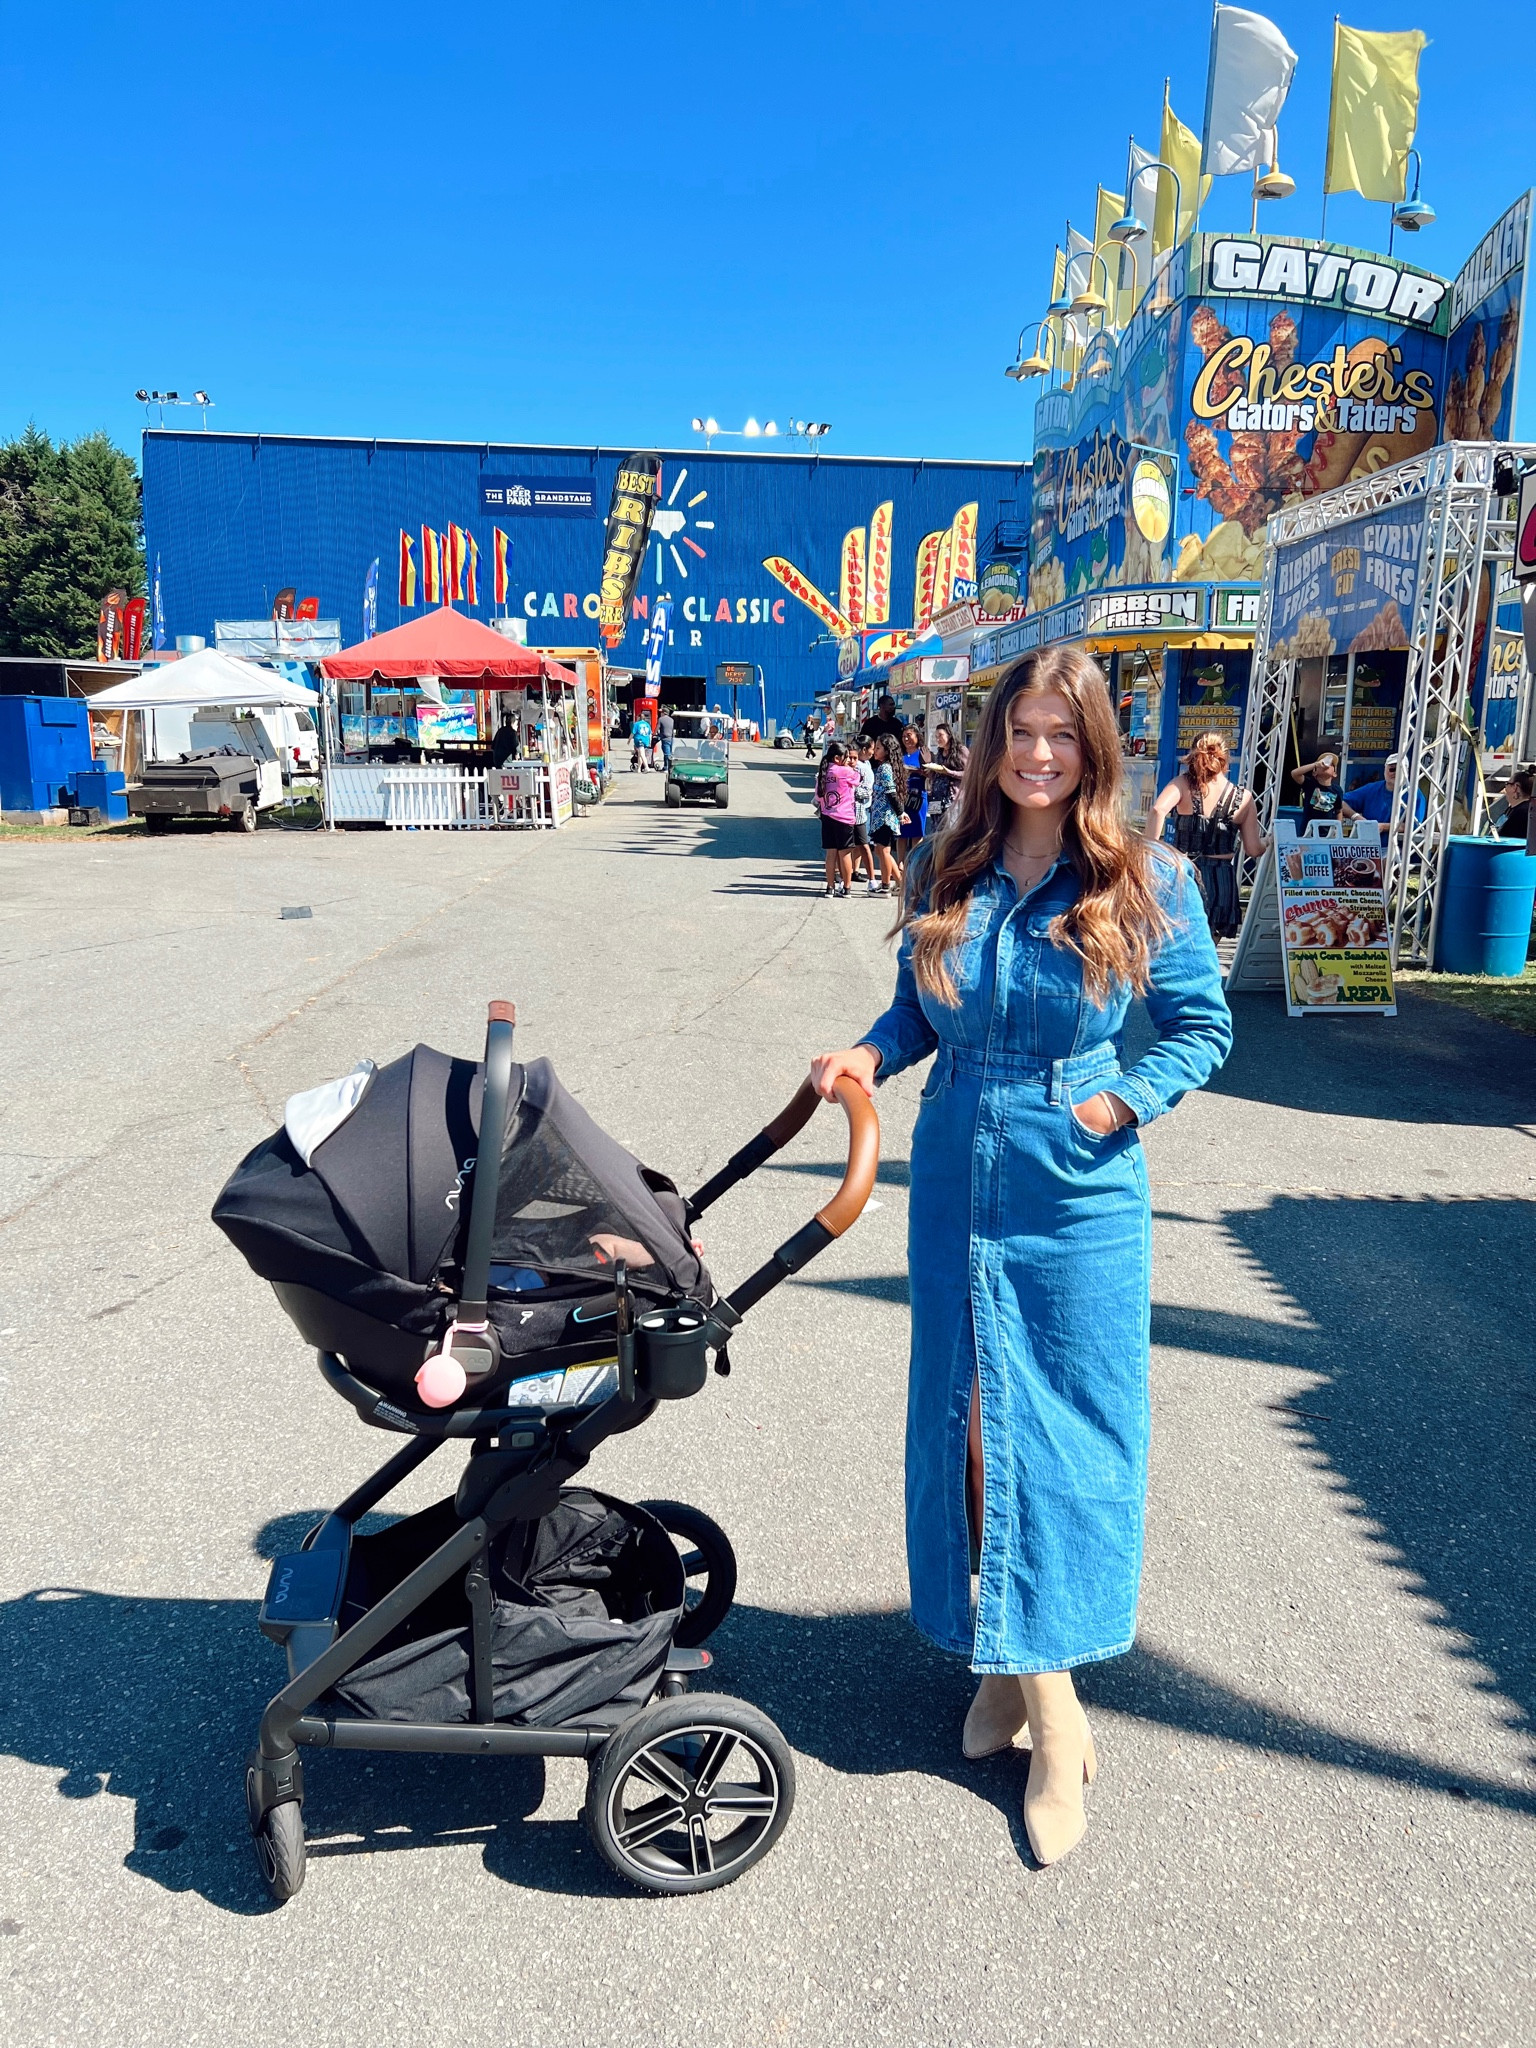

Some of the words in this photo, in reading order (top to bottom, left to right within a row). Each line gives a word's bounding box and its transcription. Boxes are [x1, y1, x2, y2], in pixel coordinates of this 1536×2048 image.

[1450, 196, 1528, 332] CHICKEN
[1210, 240, 1446, 325] GATOR
[1120, 248, 1185, 380] GATOR
[1191, 337, 1434, 418] Chester's
[1228, 397, 1316, 432] Gators
[1315, 393, 1345, 434] &
[1336, 399, 1417, 432] Taters
[618, 470, 656, 495] BEST
[485, 492, 503, 500] THE
[506, 488, 531, 498] DEER
[506, 496, 532, 507] PARK
[534, 494, 592, 503] GRANDSTAND
[601, 496, 645, 600] RIBS
[1364, 521, 1424, 561] CURLY
[1278, 541, 1327, 596] RIBBON
[1331, 547, 1360, 578] FRESH
[980, 575, 1018, 590] LEMONADE
[1335, 574, 1354, 597] CUT
[1365, 556, 1415, 606] FRIES
[774, 559, 847, 634] LEMONADE
[1282, 573, 1320, 627] FRIES
[524, 591, 648, 619] CARON
[683, 596, 785, 624] CLASSIC
[600, 605, 624, 625] ERE
[1089, 592, 1197, 628] RIBBON
[1107, 611, 1162, 628] FRIES
[646, 606, 667, 683] ATM
[890, 633, 914, 648] IC
[645, 684, 660, 695] ERE
[936, 694, 958, 708] OREO
[1185, 706, 1234, 715] KABOBS
[1370, 708, 1393, 716] FRIES
[1180, 717, 1211, 726] LOADED
[1214, 717, 1237, 726] FRIES
[1366, 719, 1392, 727] DOGS
[1303, 853, 1329, 865] ICED
[1331, 845, 1349, 859] HOT
[1350, 845, 1380, 858] COFFEE
[1304, 865, 1330, 877] COFFEE
[1284, 889, 1303, 897] Filled
[1321, 889, 1349, 898] Caramel,
[1350, 889, 1382, 898] Chocolate,
[1359, 897, 1383, 905] Cheese,
[1285, 897, 1337, 921] Churros
[1349, 904, 1383, 913] Strawberry
[1365, 912, 1384, 920] Guava
[1288, 950, 1318, 961] Sweet
[1319, 950, 1343, 961] Corn
[1344, 950, 1388, 961] Sandwich
[1336, 985, 1392, 1002] AREPA
[445, 1158, 478, 1210] nuna
[383, 1401, 408, 1418] WARNING
[275, 1567, 294, 1604] nuna
